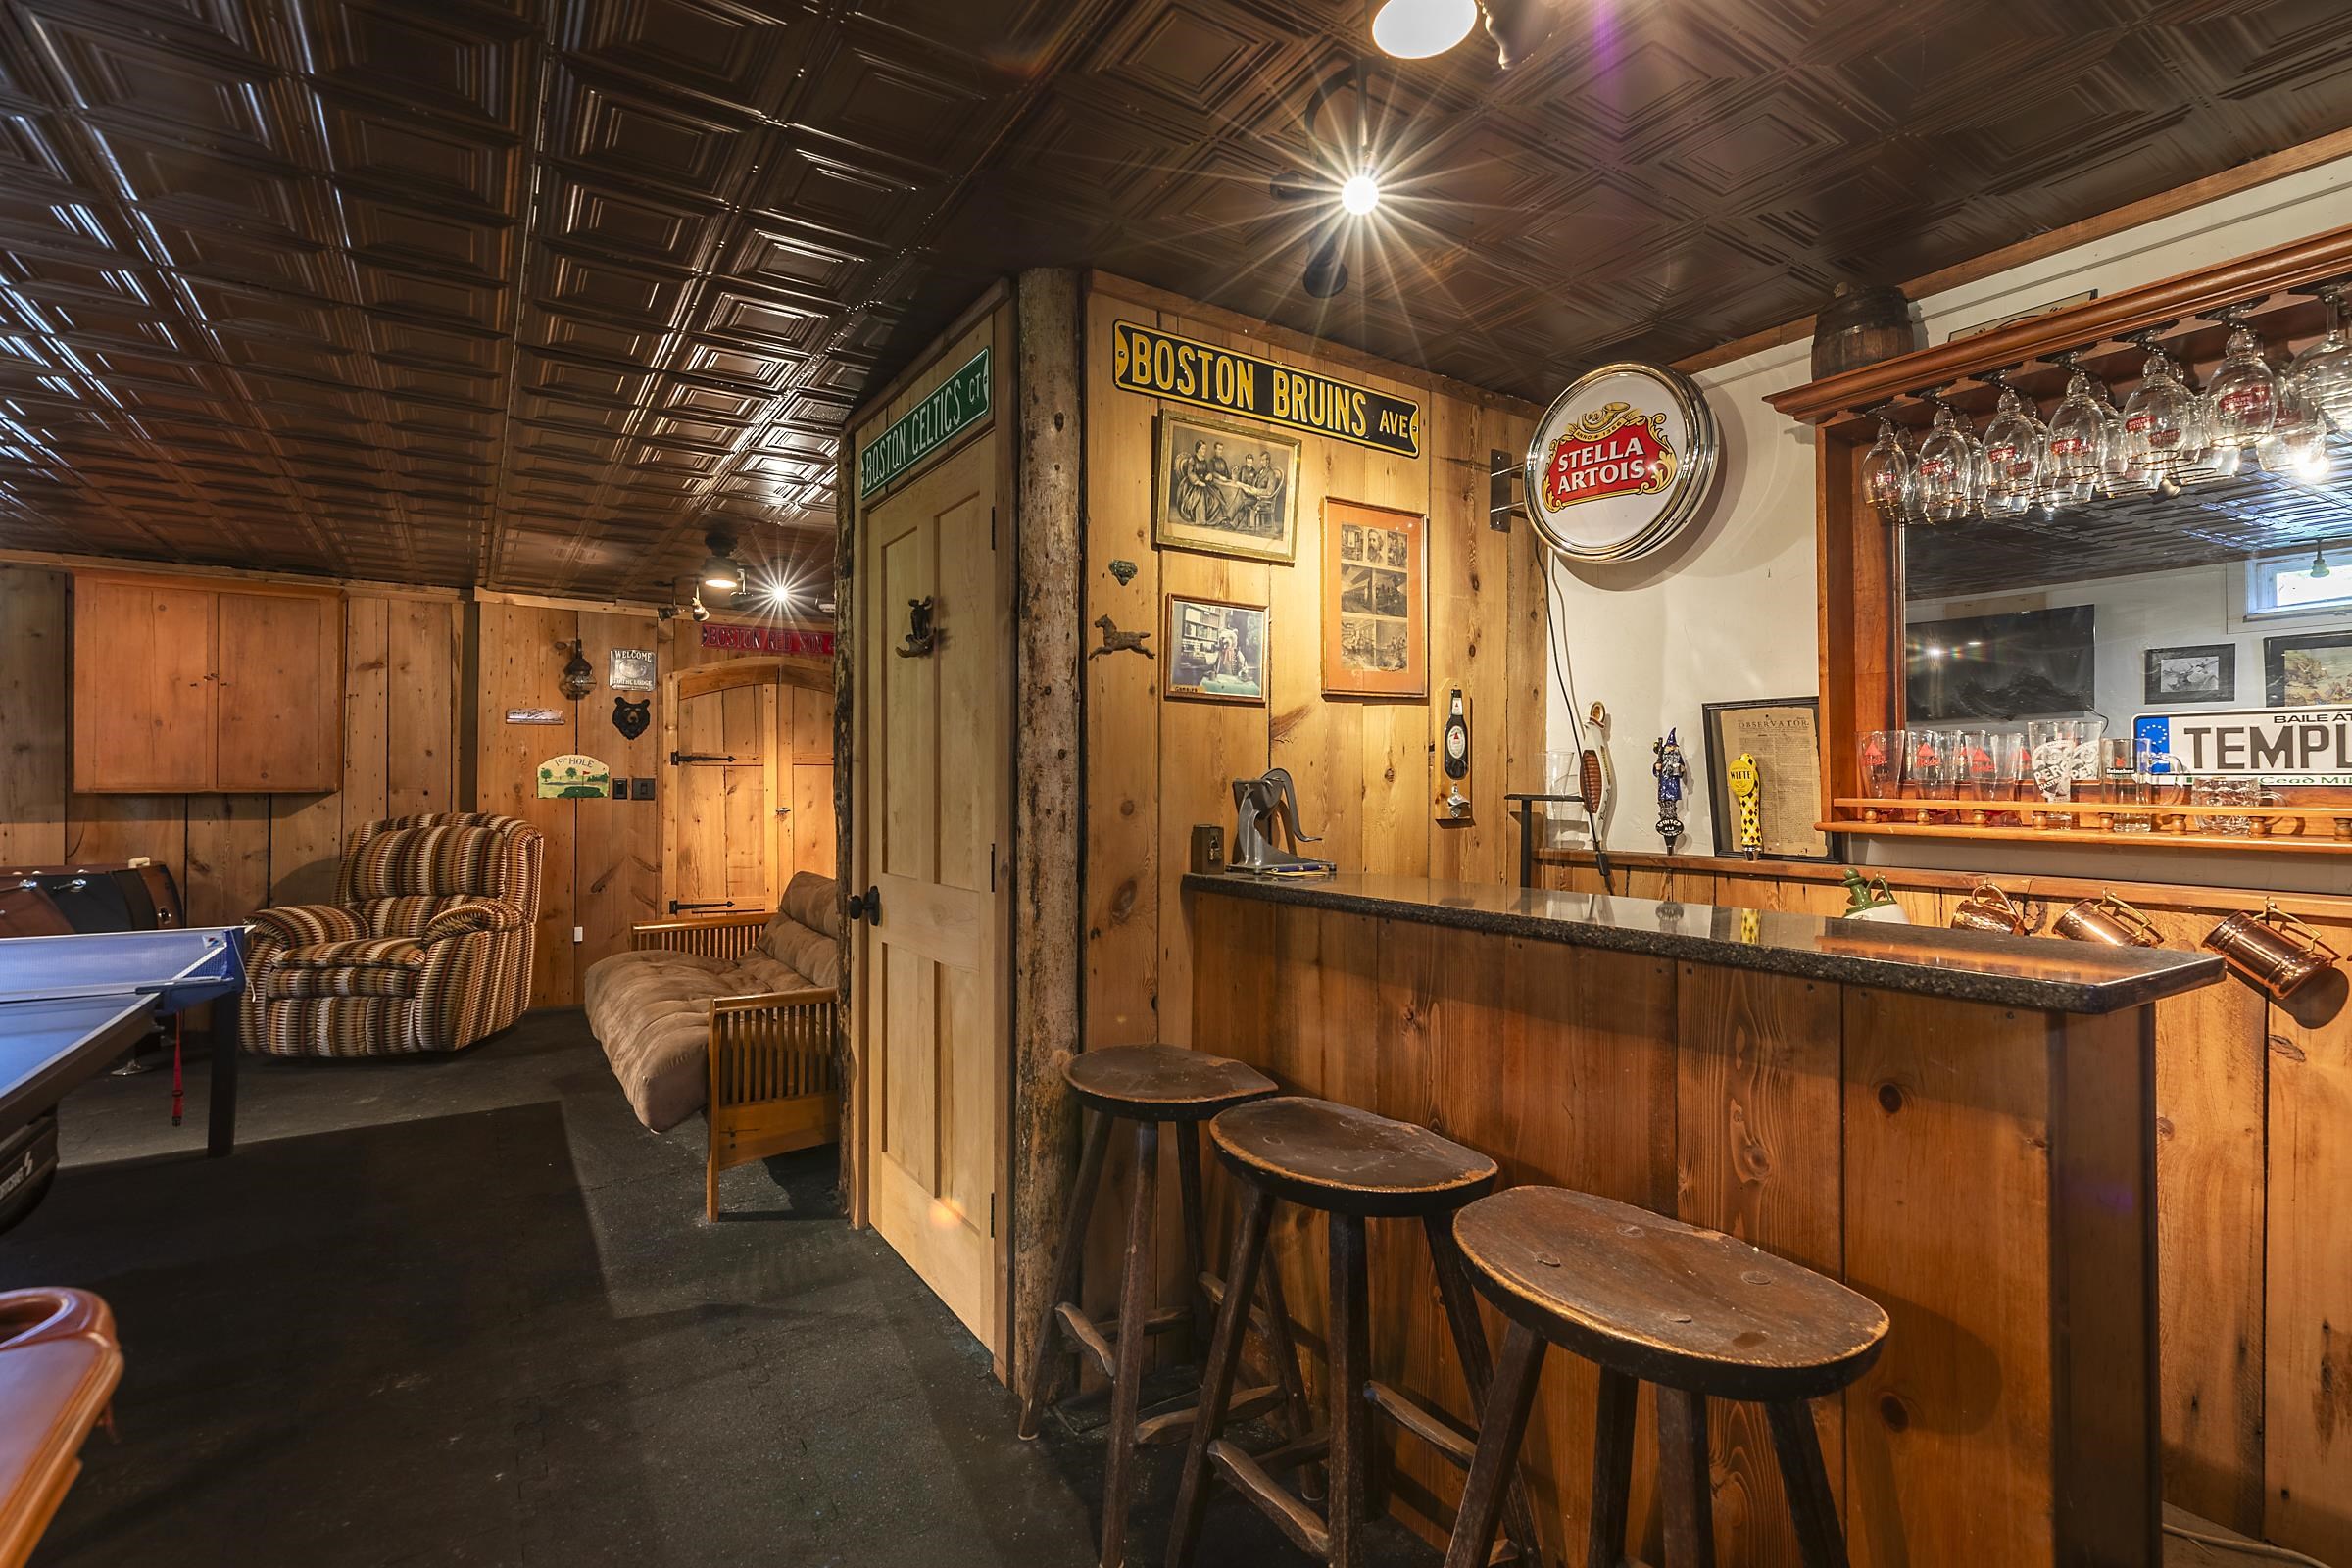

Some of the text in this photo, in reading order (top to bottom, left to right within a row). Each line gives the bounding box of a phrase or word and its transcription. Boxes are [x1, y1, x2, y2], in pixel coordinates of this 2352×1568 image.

[1132, 332, 1409, 439] BOSTON BRUINS AVE
[866, 372, 981, 489] BOSTON CELTICS CT
[1576, 431, 1592, 440] ANNO
[1558, 437, 1644, 472] STELLA
[1557, 459, 1645, 494] ARTOIS
[710, 626, 761, 649] BOSTON
[767, 630, 793, 651] RED
[799, 633, 824, 653] SOX
[614, 649, 652, 662] WELCOME
[2274, 714, 2328, 724] BAILE
[2184, 724, 2352, 769] TEMPL
[569, 758, 594, 768] HOLE
[1731, 770, 1751, 780] WITTE
